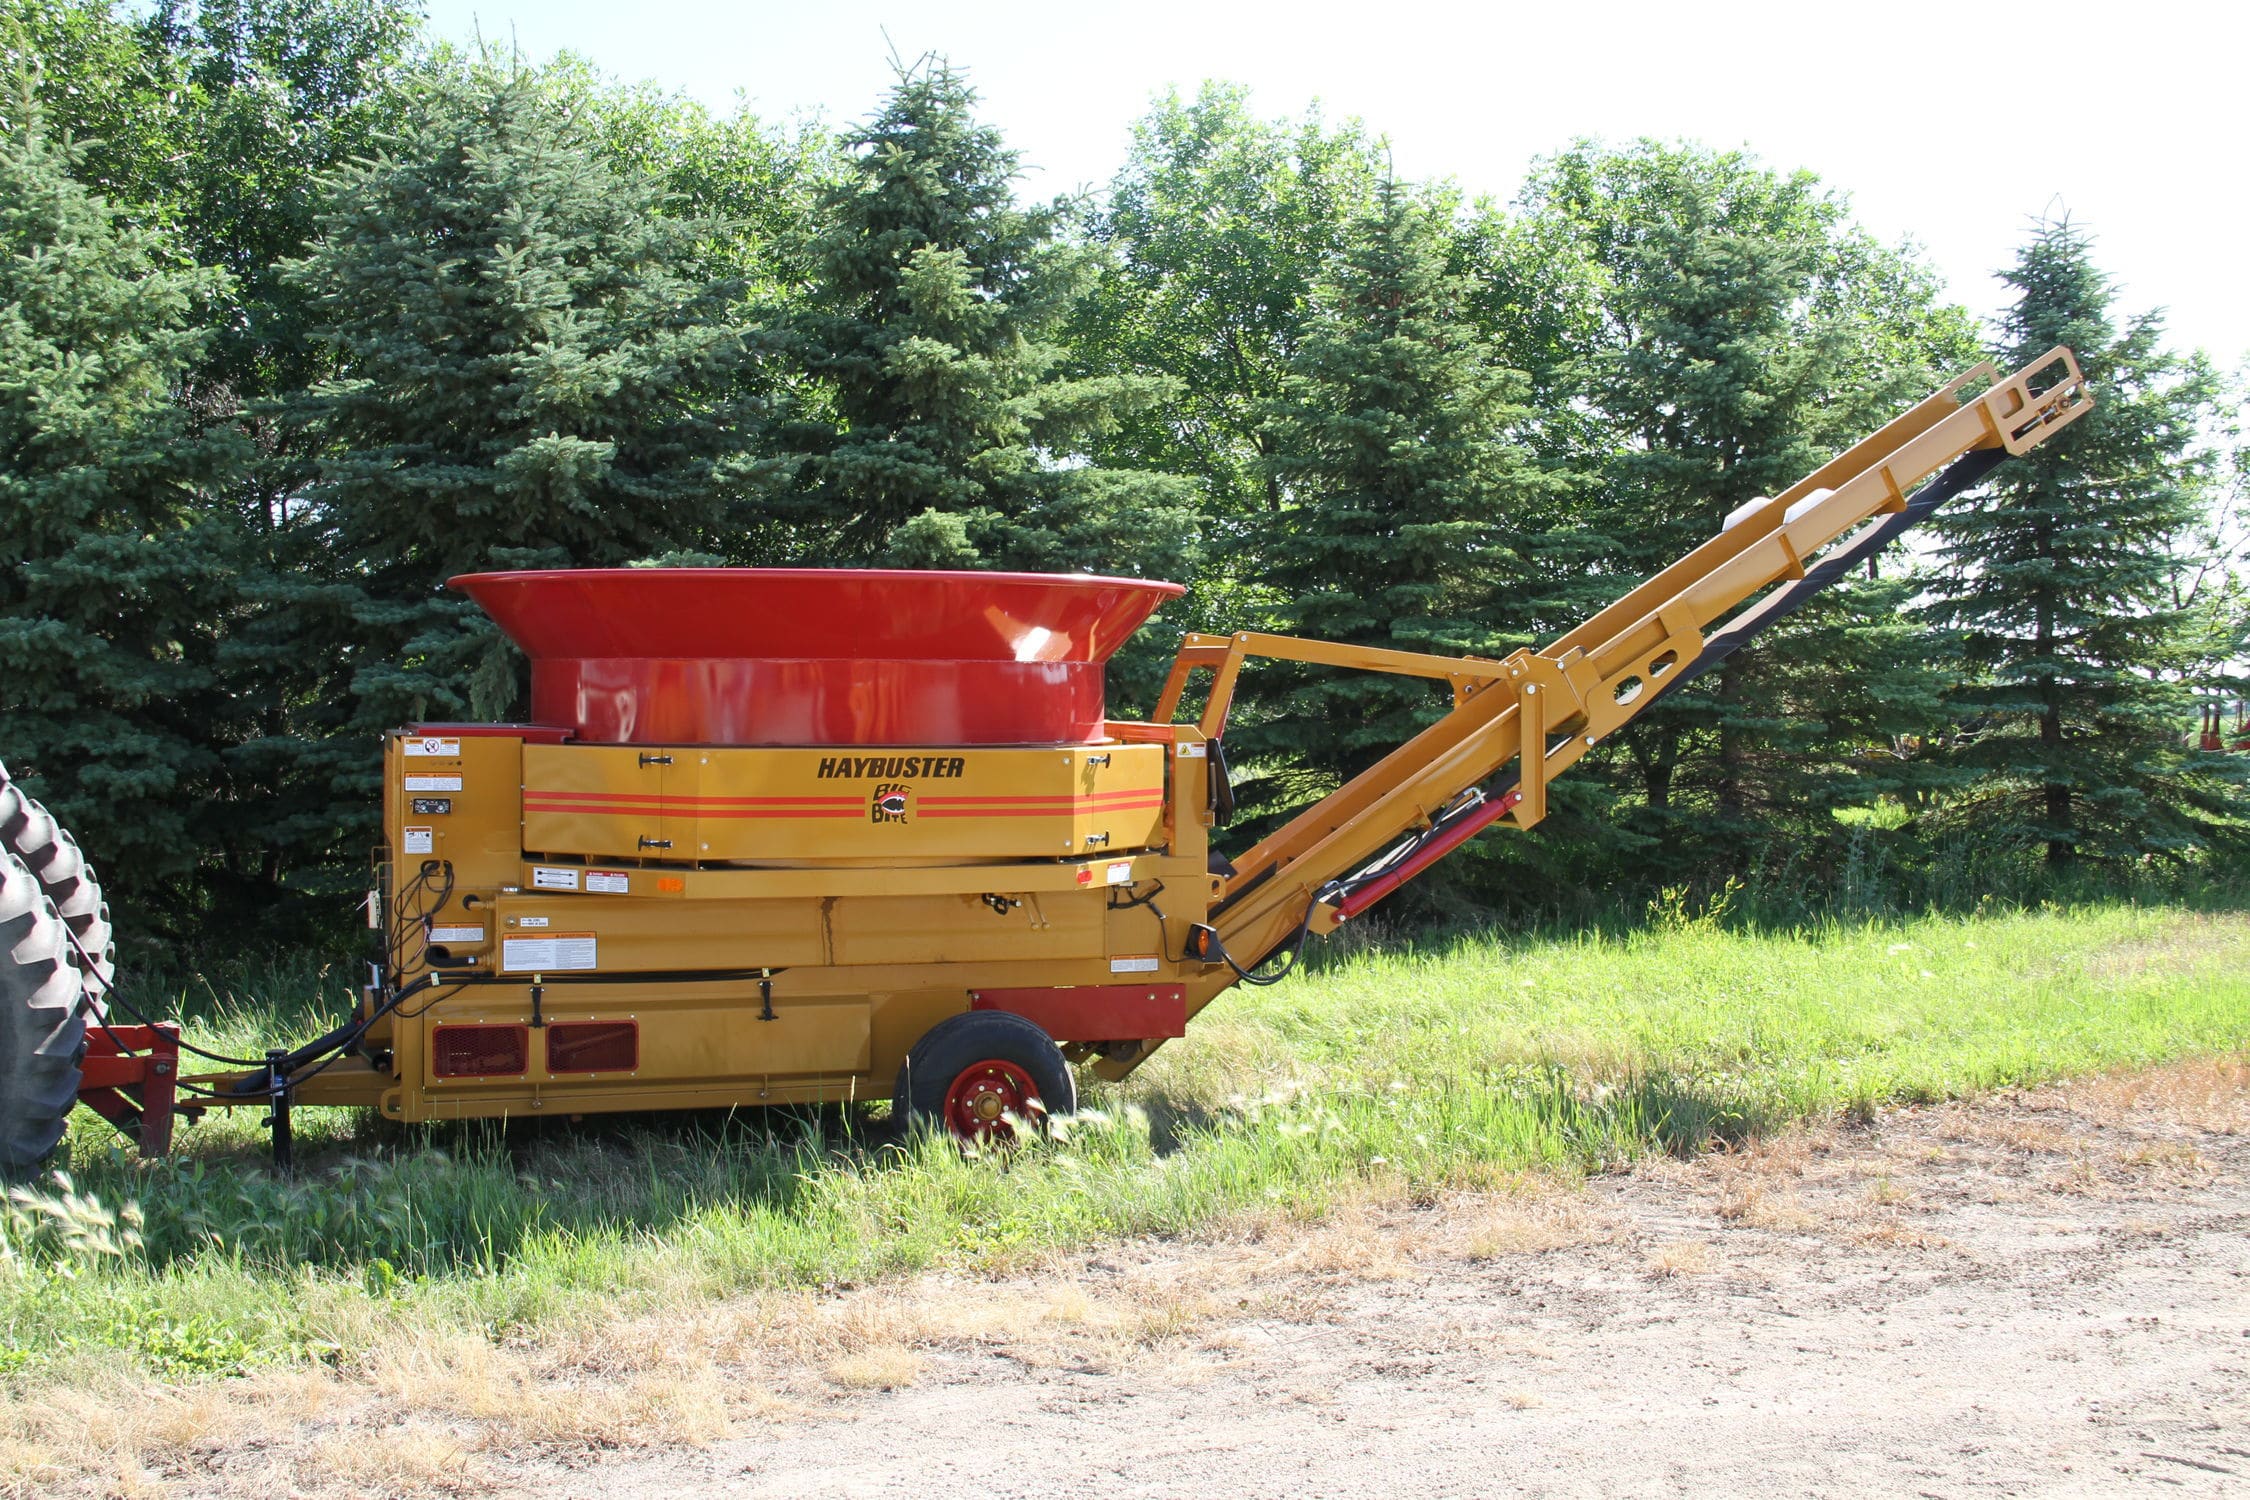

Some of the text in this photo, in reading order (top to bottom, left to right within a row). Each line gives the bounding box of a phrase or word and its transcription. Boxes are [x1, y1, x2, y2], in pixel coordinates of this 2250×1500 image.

[817, 757, 965, 778] HAYBUSTER
[873, 784, 912, 801] BIG
[872, 803, 908, 824] BITE
